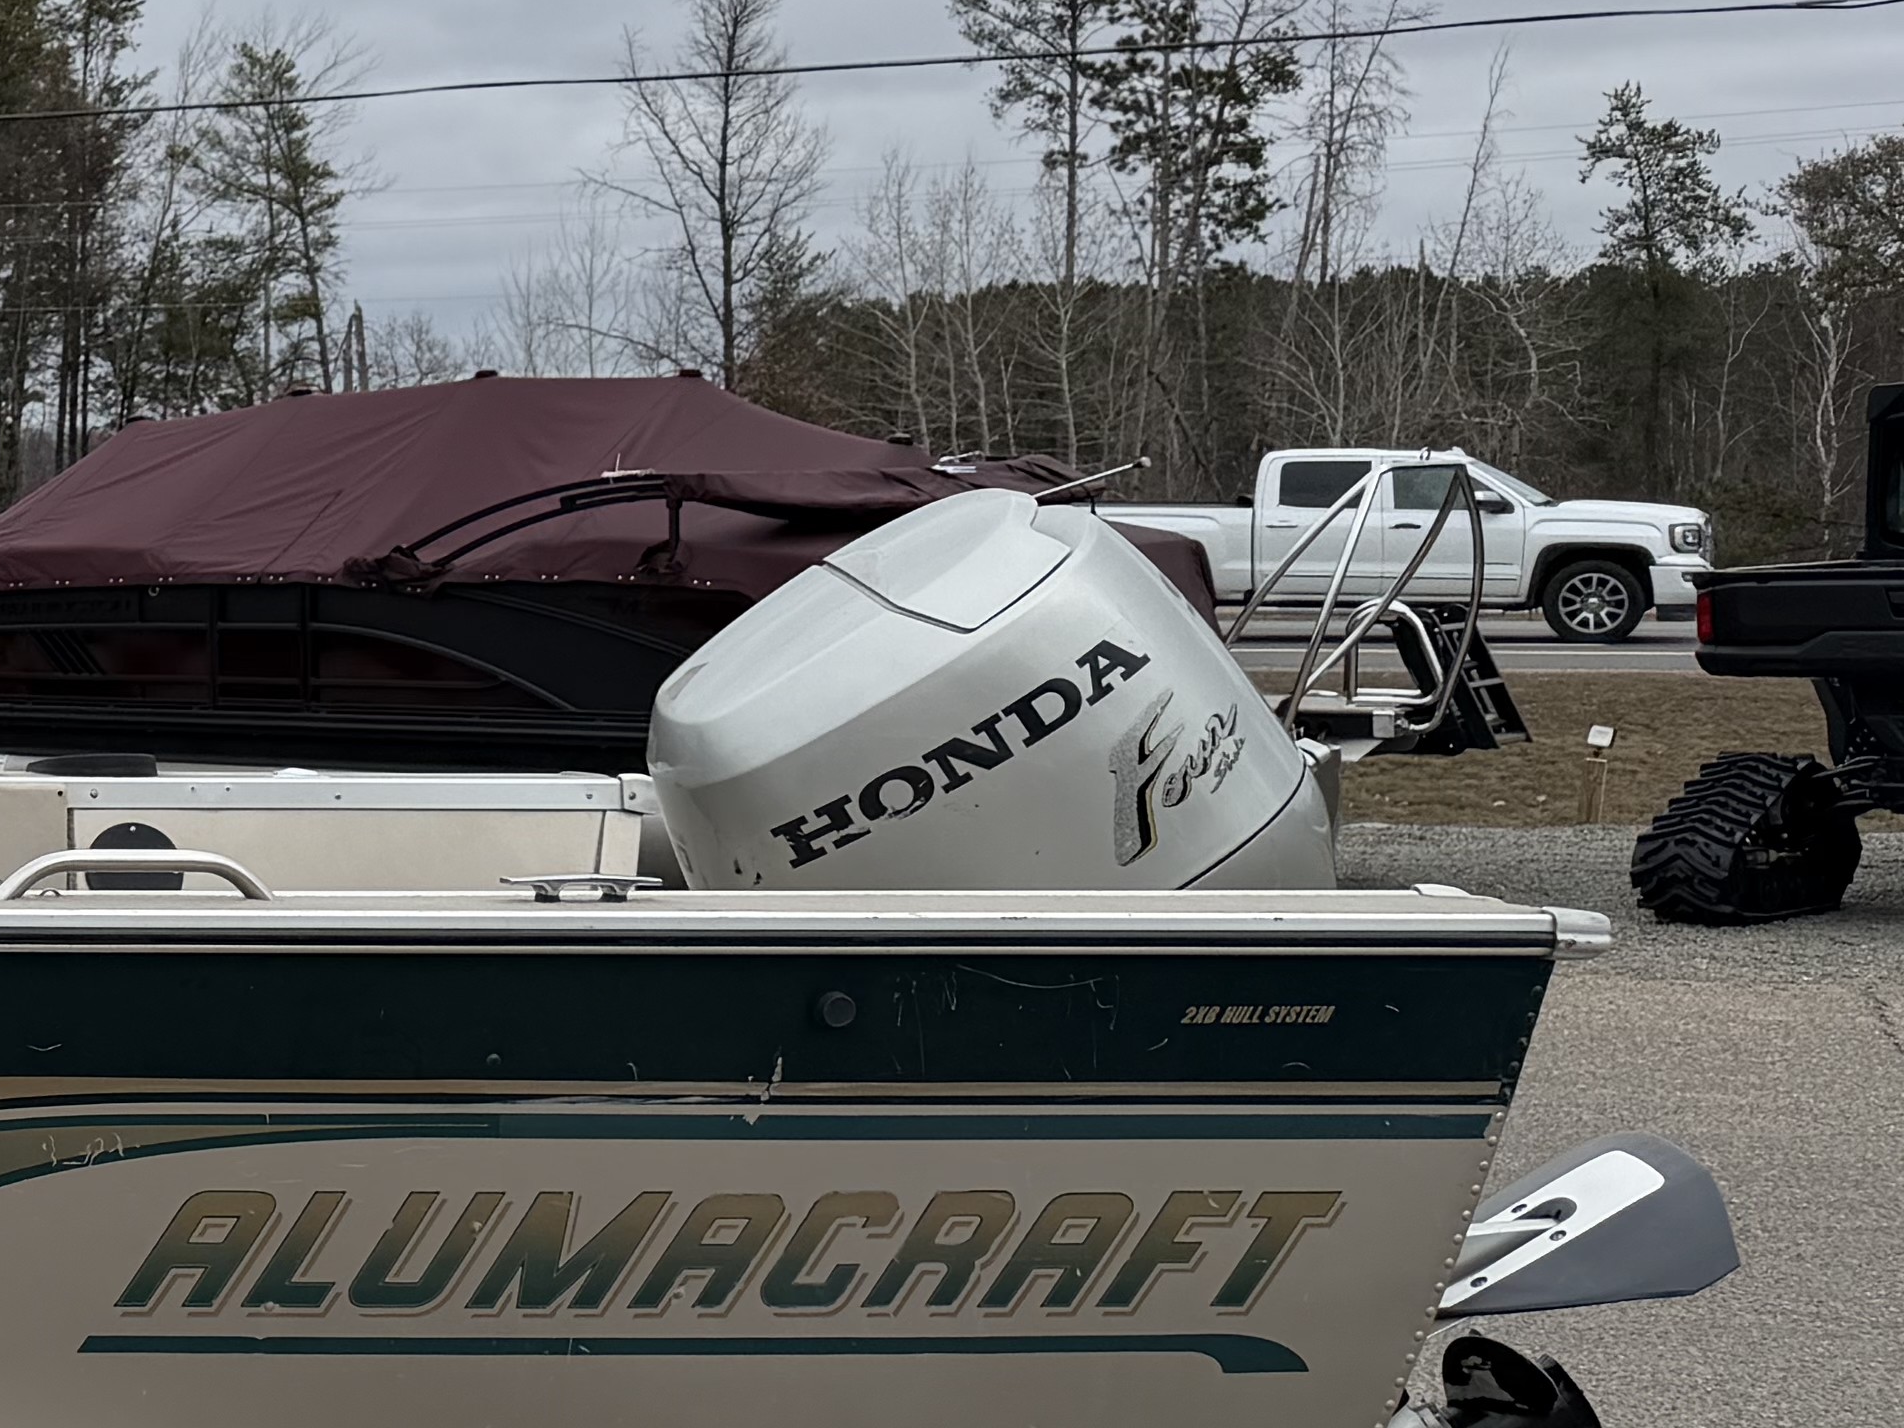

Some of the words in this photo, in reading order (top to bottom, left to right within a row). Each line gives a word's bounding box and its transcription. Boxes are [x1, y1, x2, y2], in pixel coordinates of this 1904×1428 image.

[769, 638, 1151, 870] HONDA
[1220, 1005, 1263, 1023] HULL
[1264, 1005, 1336, 1023] SYSTEM
[113, 1189, 1345, 1314] ALUMACRAFT
